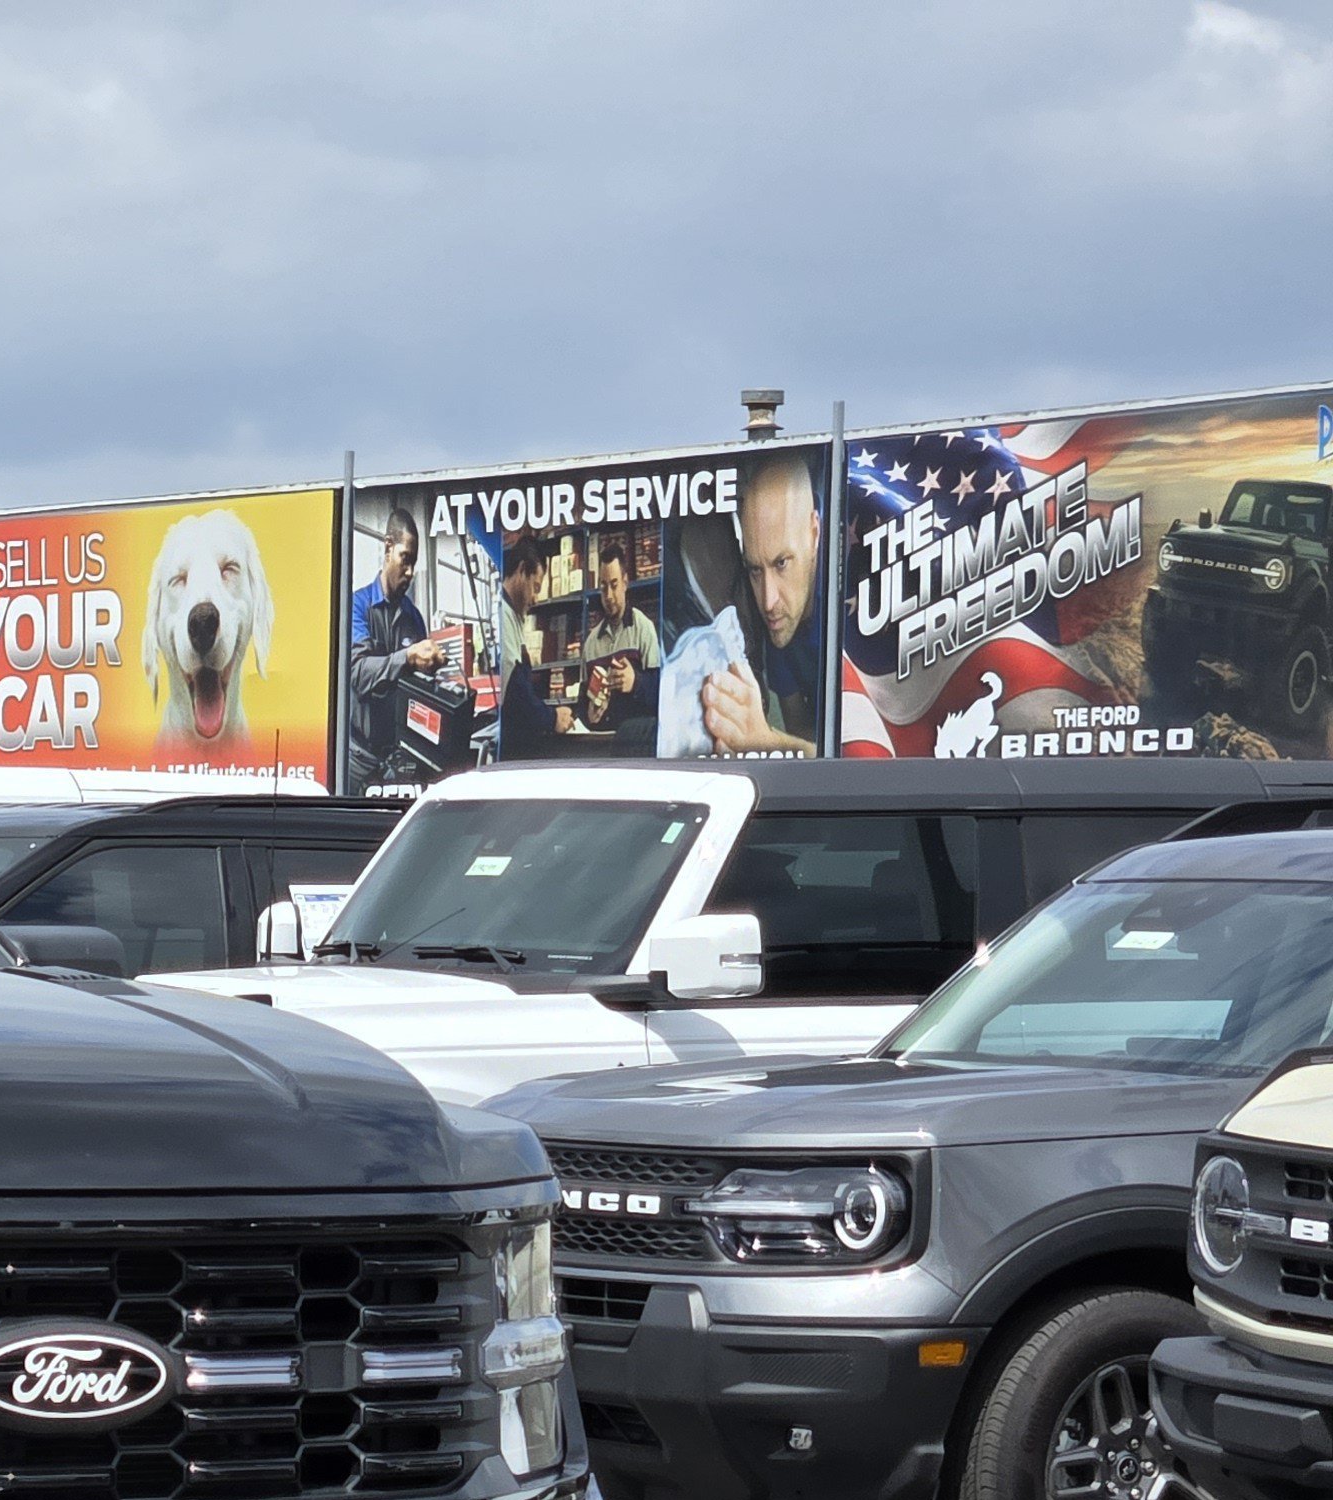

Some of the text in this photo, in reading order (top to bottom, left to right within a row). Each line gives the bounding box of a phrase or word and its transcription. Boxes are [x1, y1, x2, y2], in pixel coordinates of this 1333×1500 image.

[429, 468, 738, 537] AT YOUR SERVICE
[63, 532, 106, 584] US
[858, 461, 1087, 637] ULTIMATE
[863, 499, 935, 574] THE
[898, 497, 1142, 681] FREEDOM!
[1001, 727, 1194, 759] BRONCO
[1053, 705, 1140, 728] THE FORD
[12, 1346, 131, 1403] Ford
